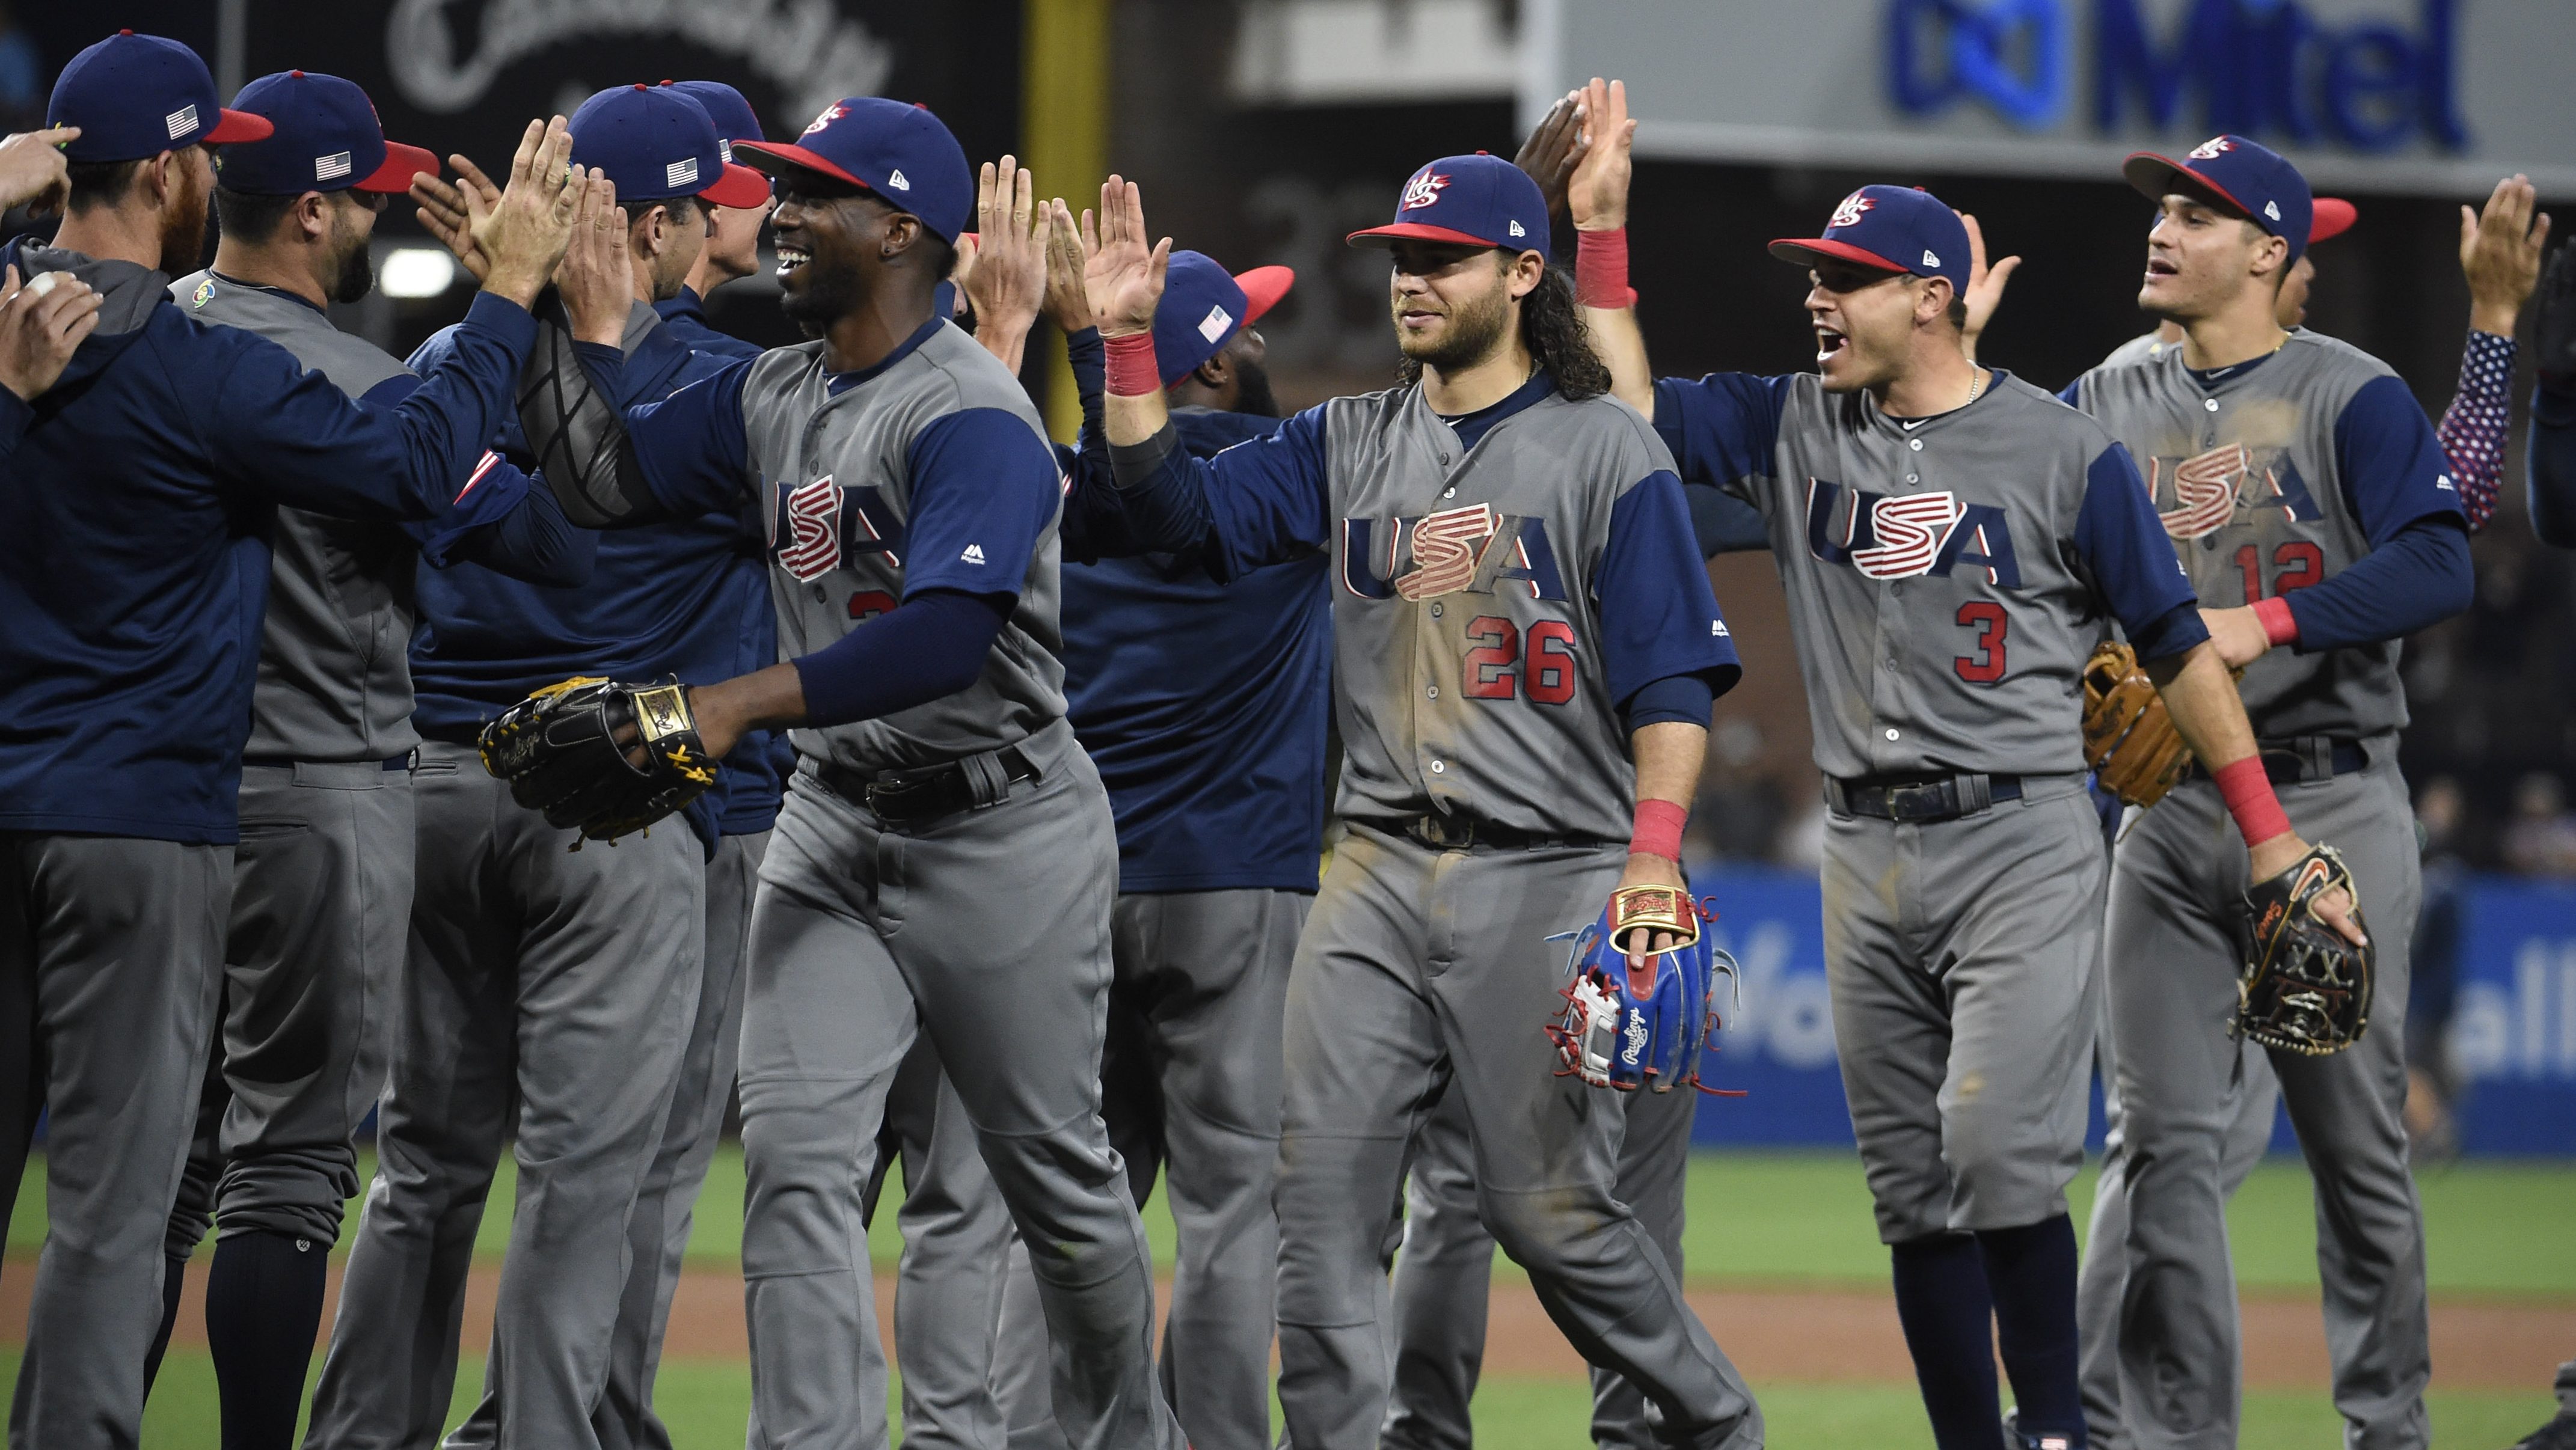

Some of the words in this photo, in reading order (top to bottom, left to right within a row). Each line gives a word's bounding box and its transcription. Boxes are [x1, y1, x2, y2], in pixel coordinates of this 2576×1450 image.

[1342, 503, 1569, 602] USA
[1806, 476, 2022, 580] USA
[1462, 615, 1577, 705] 26
[1954, 602, 2008, 683] 3
[1621, 1007, 1646, 1065] Rawlings
